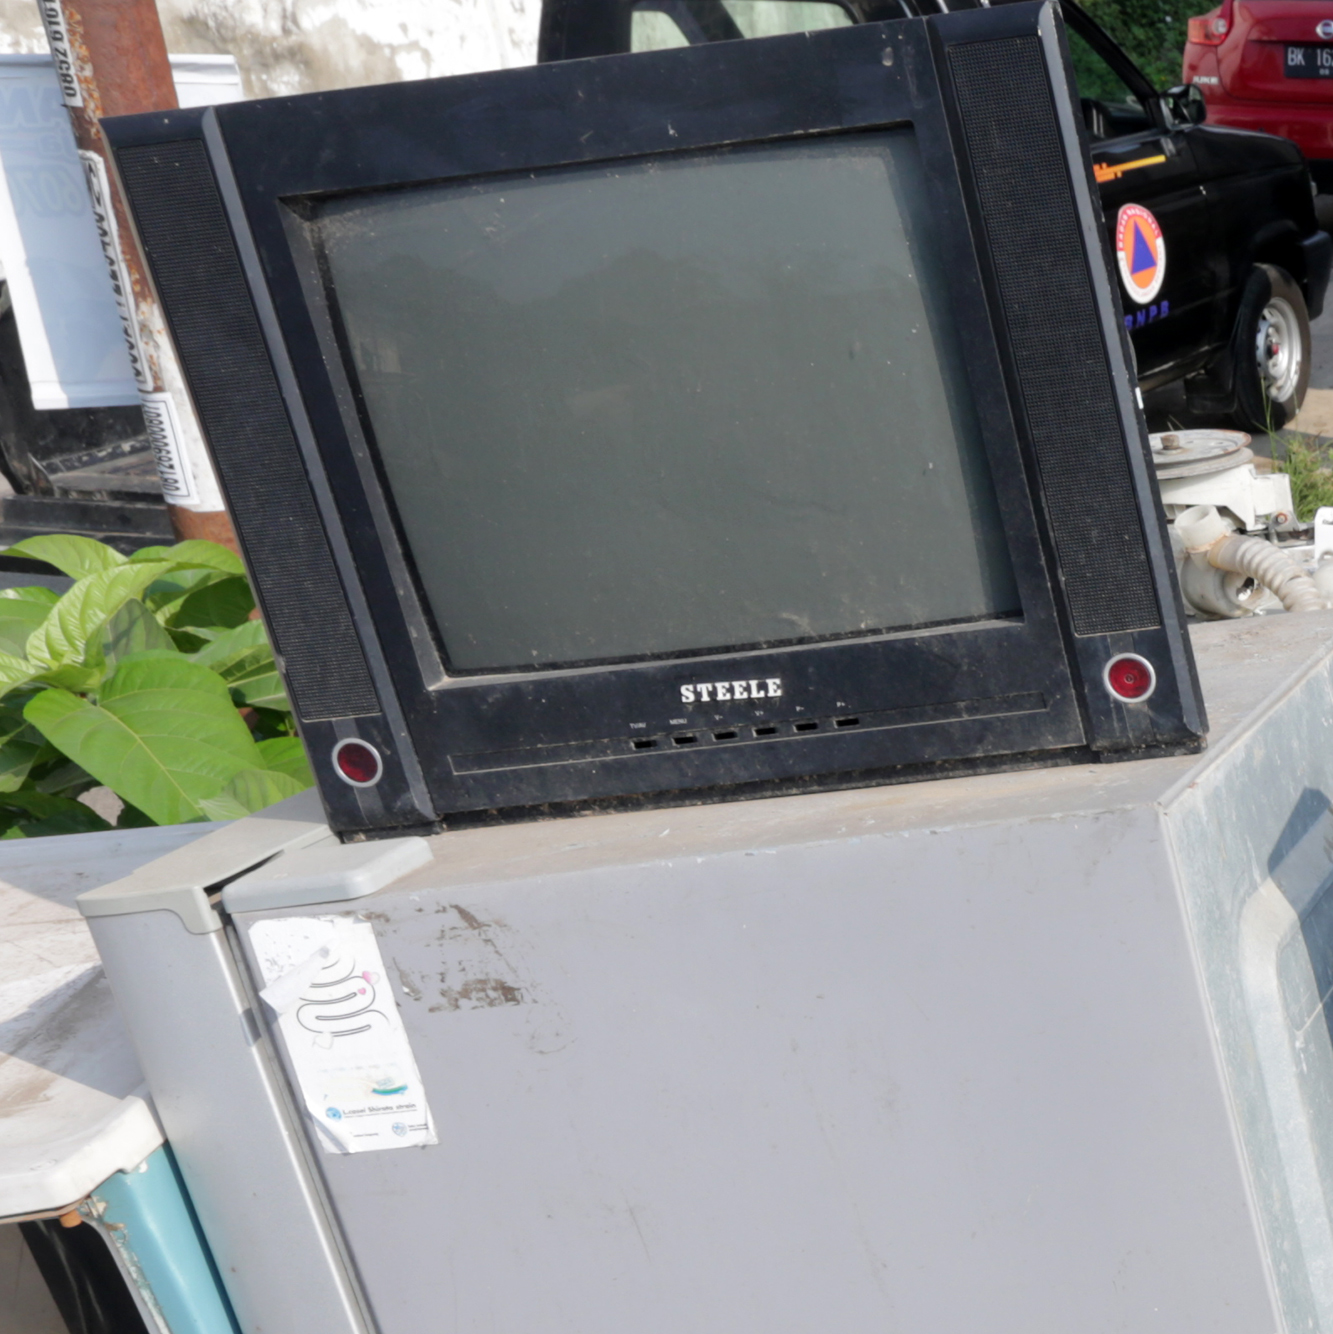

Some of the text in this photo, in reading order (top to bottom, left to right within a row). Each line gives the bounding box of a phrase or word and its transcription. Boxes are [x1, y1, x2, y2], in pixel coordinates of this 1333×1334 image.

[1287, 47, 1305, 66] BK
[1125, 300, 1171, 331] BNPB
[680, 677, 783, 704] STEELE
[669, 717, 688, 726] MENU
